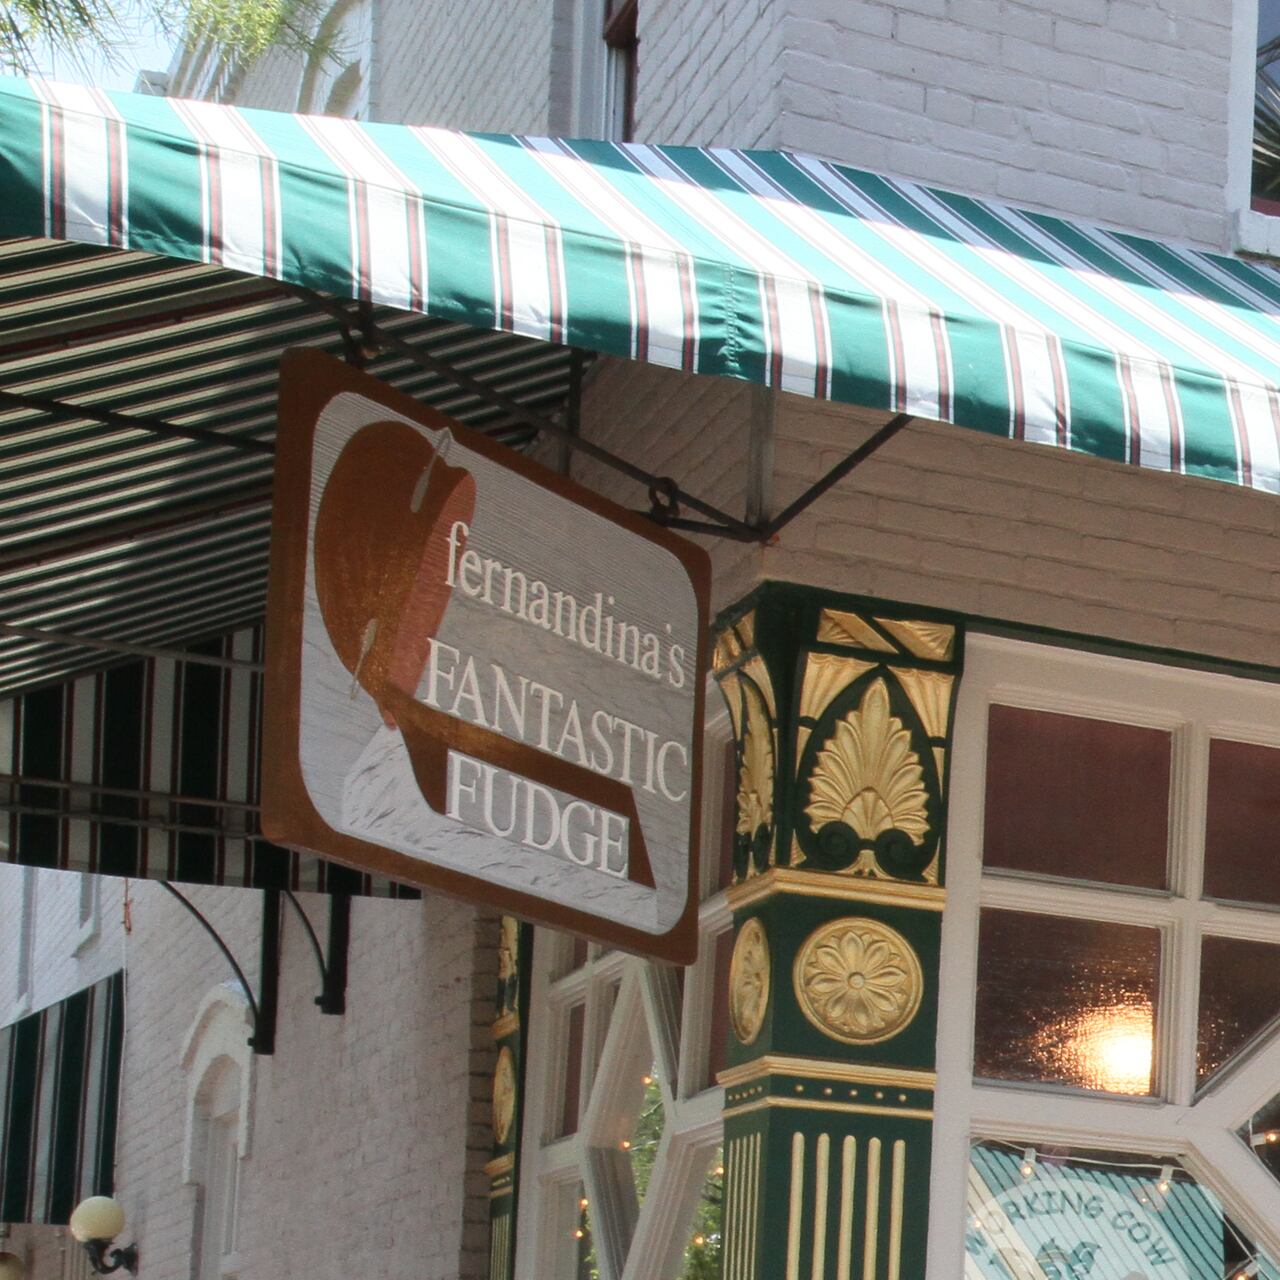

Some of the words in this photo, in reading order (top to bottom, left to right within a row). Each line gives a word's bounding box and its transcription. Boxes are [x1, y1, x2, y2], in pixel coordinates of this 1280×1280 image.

[445, 520, 685, 689] fernandina's
[423, 637, 688, 802] FANTASTIC
[446, 748, 629, 878] FUDGE
[965, 1190, 1104, 1256] WORKING
[1111, 1210, 1176, 1266] COW
